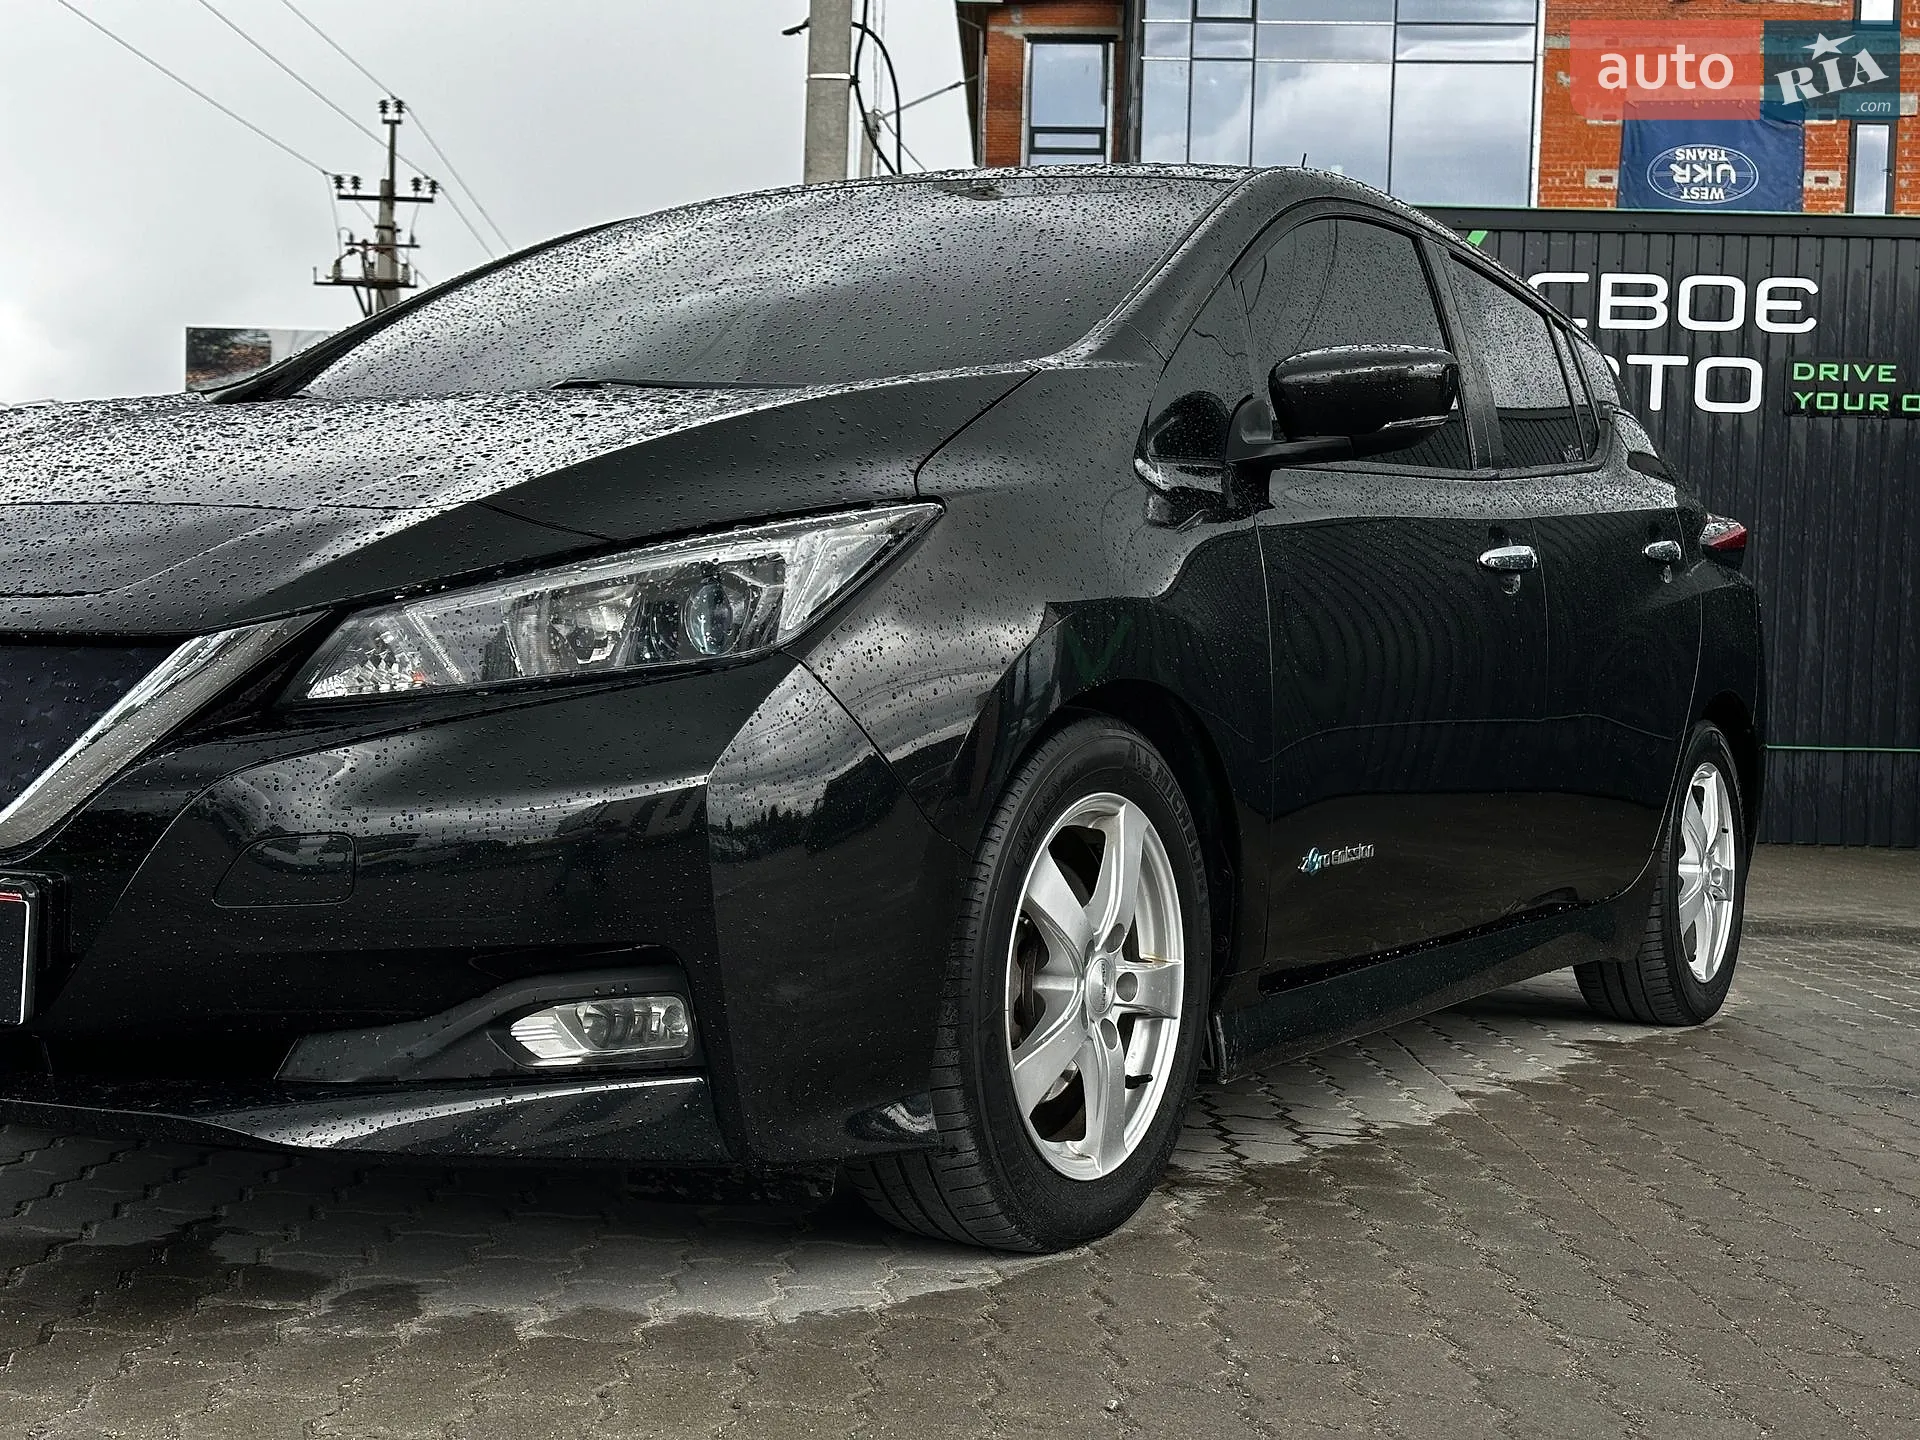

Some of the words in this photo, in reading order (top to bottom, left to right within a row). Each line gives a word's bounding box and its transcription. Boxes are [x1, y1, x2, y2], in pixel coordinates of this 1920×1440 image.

[1675, 148, 1728, 161] TRANS
[1669, 163, 1736, 184] UKR
[1680, 187, 1725, 200] WEST
[1793, 362, 1897, 383] DRIVE
[1603, 353, 1763, 413] ТО
[1793, 391, 1889, 411] YOUR
